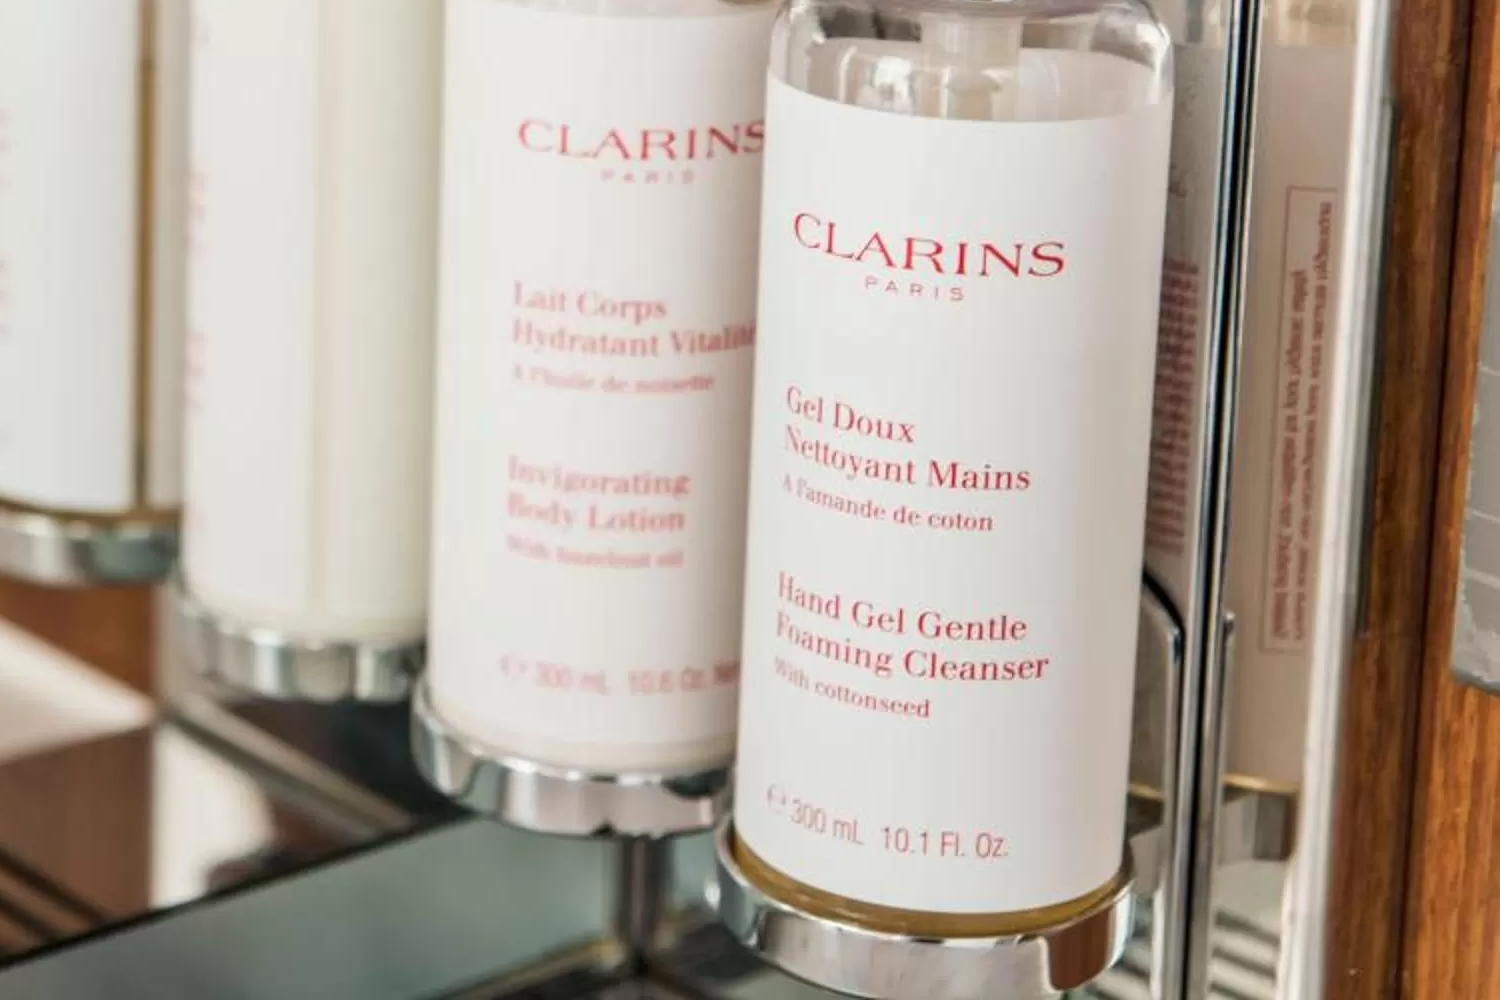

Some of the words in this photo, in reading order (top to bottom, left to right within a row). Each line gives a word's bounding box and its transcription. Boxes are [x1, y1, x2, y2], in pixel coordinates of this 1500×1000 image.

[517, 118, 764, 162] CLARINS
[600, 169, 696, 185] PARIS
[794, 212, 1066, 277] CLARINS
[513, 280, 568, 313] Lait
[576, 291, 668, 326] Corps
[865, 274, 966, 302] PARIS
[512, 316, 660, 359] Hydratant
[786, 385, 824, 424] Gel
[833, 401, 916, 444] Doux
[507, 455, 692, 498] Invigorating
[785, 424, 916, 486] Nettoyant
[928, 459, 1032, 491] Mains
[506, 493, 575, 529] Body
[587, 503, 686, 534] Lotion
[796, 479, 887, 520] l'amande
[892, 505, 922, 526] de
[927, 512, 994, 532] coton
[778, 571, 841, 620] Hand
[850, 600, 905, 635] Gel
[916, 611, 1028, 642] Gentle
[775, 611, 894, 677] Foaming
[902, 649, 1050, 682] Cleanser
[773, 656, 810, 690] With
[814, 679, 931, 719] cottonseed
[790, 797, 828, 834] 300
[832, 818, 865, 846] mL
[881, 825, 930, 857] 10.1
[940, 830, 966, 857] Fl.
[973, 831, 1010, 859] Oz.
